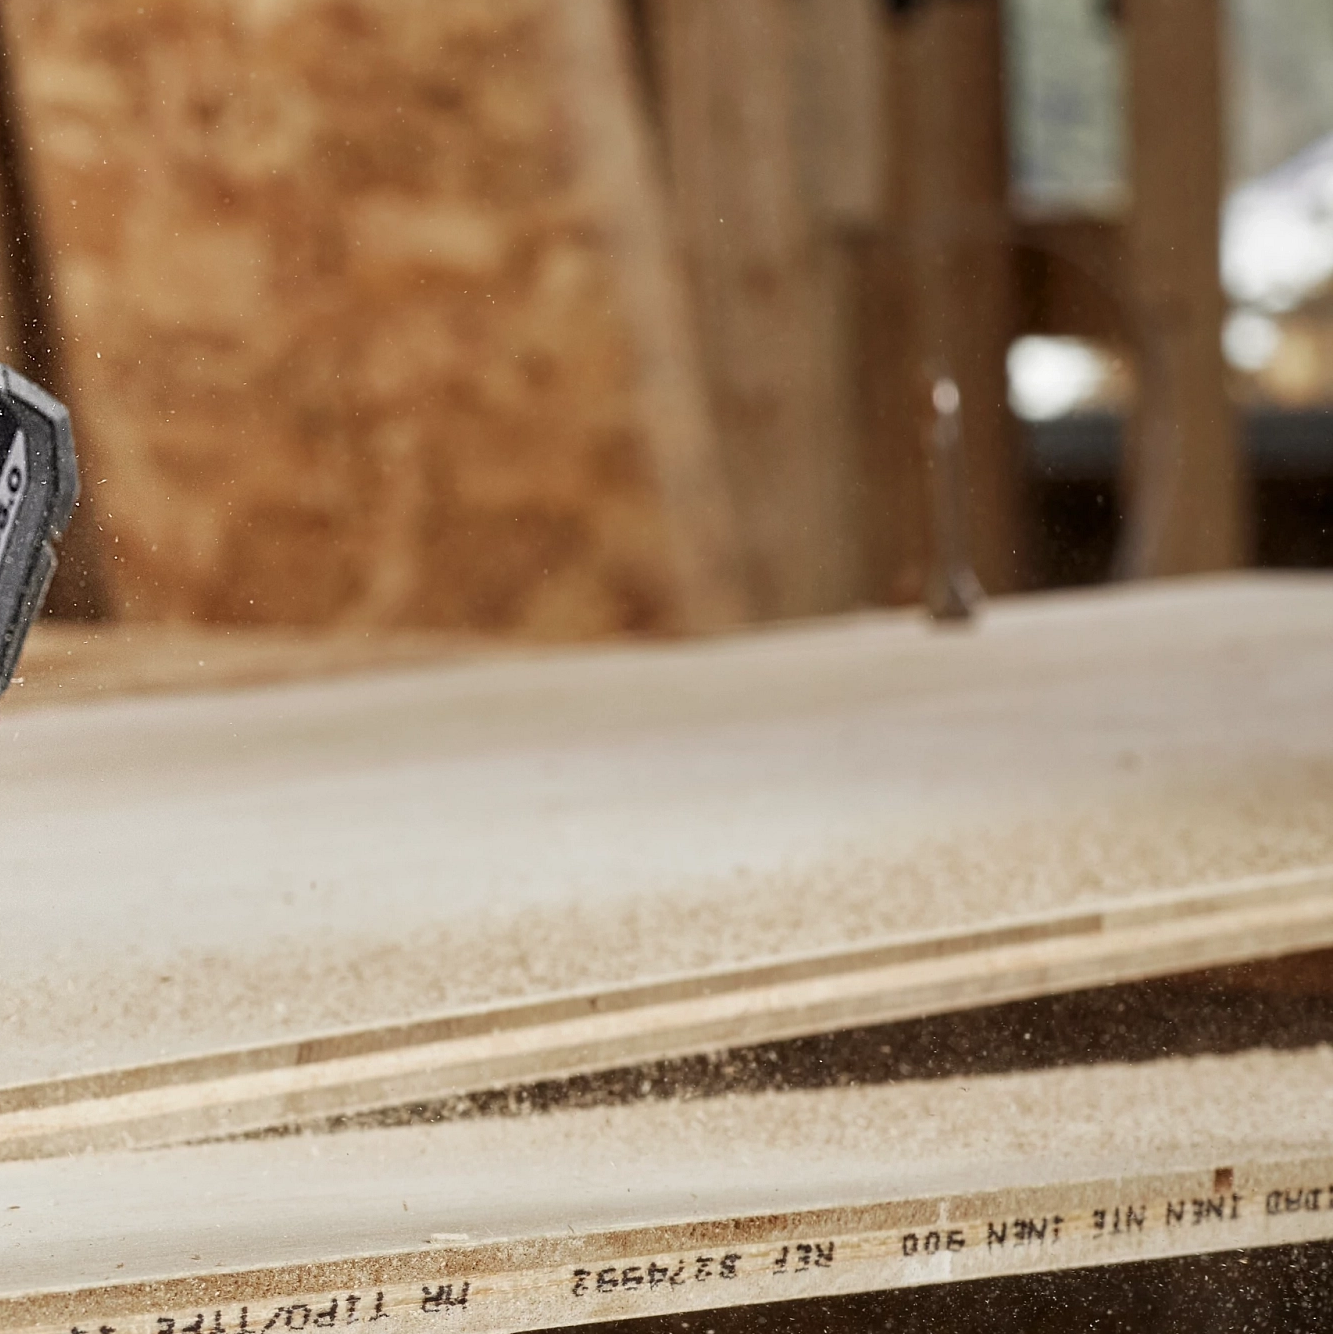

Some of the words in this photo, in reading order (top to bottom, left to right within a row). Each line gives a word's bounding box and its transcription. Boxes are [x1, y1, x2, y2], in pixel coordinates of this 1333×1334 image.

[1091, 1203, 1148, 1240] NTE
[1165, 1192, 1244, 1228] INEN
[772, 1240, 835, 1277] REF
[901, 1229, 967, 1258] 900
[419, 1280, 471, 1313] MR
